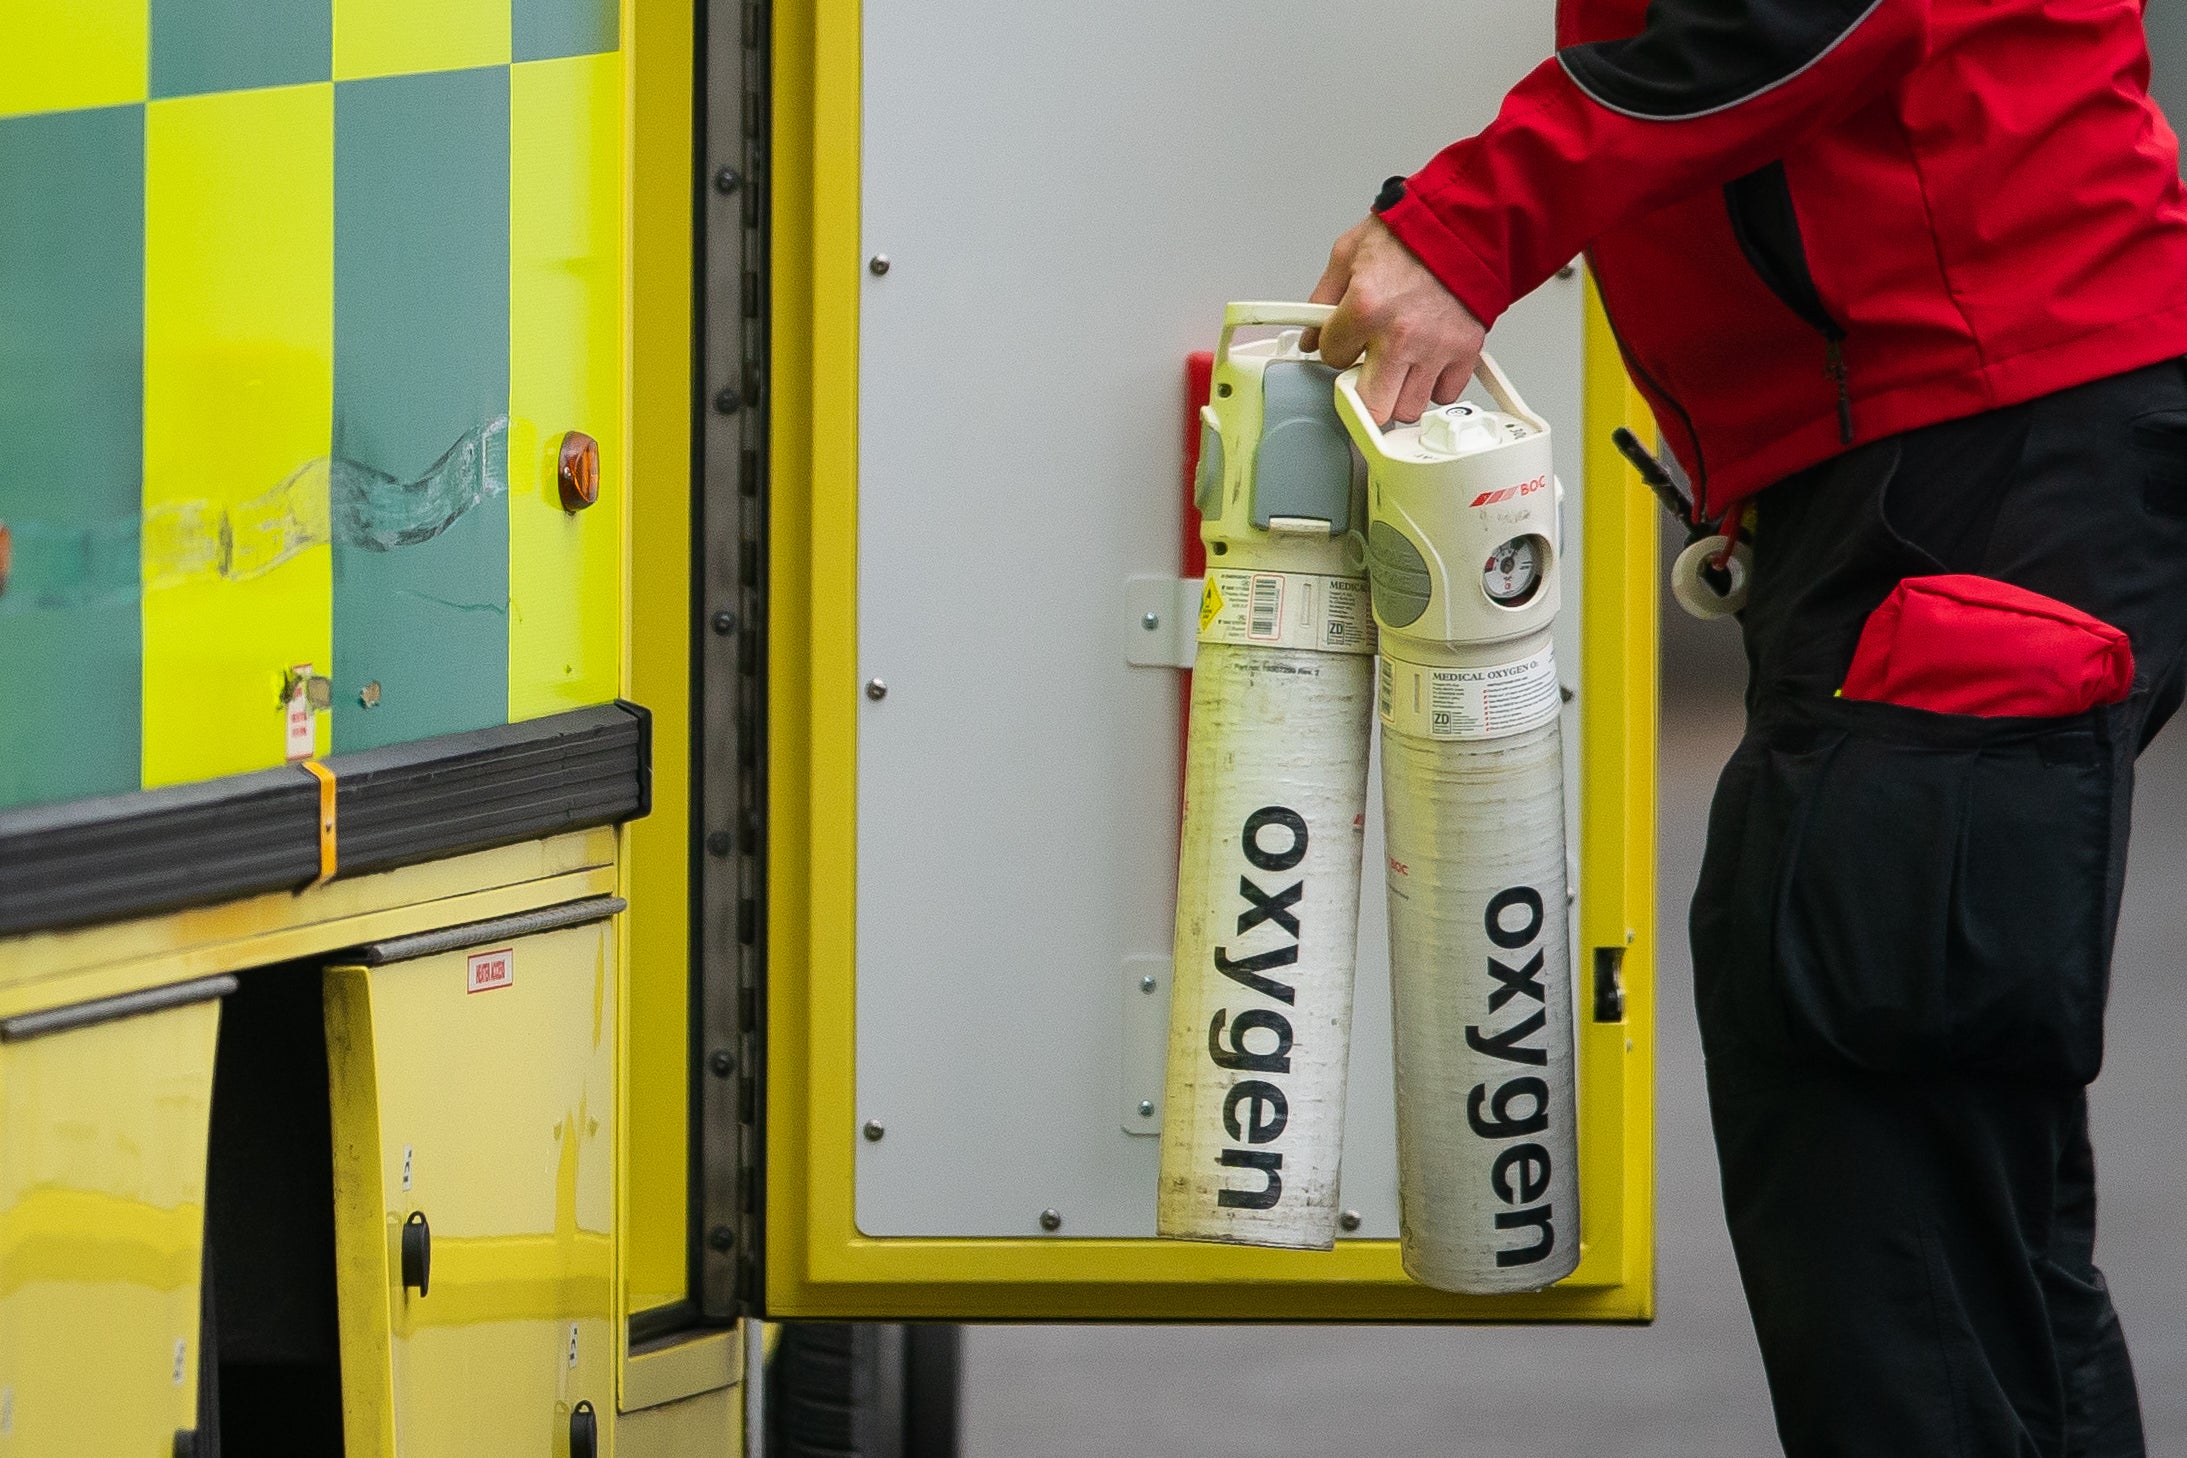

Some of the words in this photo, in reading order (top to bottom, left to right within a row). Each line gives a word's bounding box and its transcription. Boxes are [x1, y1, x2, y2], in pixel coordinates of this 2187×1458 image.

[1520, 475, 1545, 496] BOC
[1329, 581, 1371, 595] MEDICA
[1330, 623, 1343, 635] ZD
[1432, 672, 1486, 682] MEDICAL
[1487, 663, 1529, 679] OXYGEN
[1434, 713, 1450, 725] ZD
[1390, 857, 1409, 877] BOC
[1208, 806, 1309, 1210] oxygen
[1465, 886, 1555, 1268] oxygen
